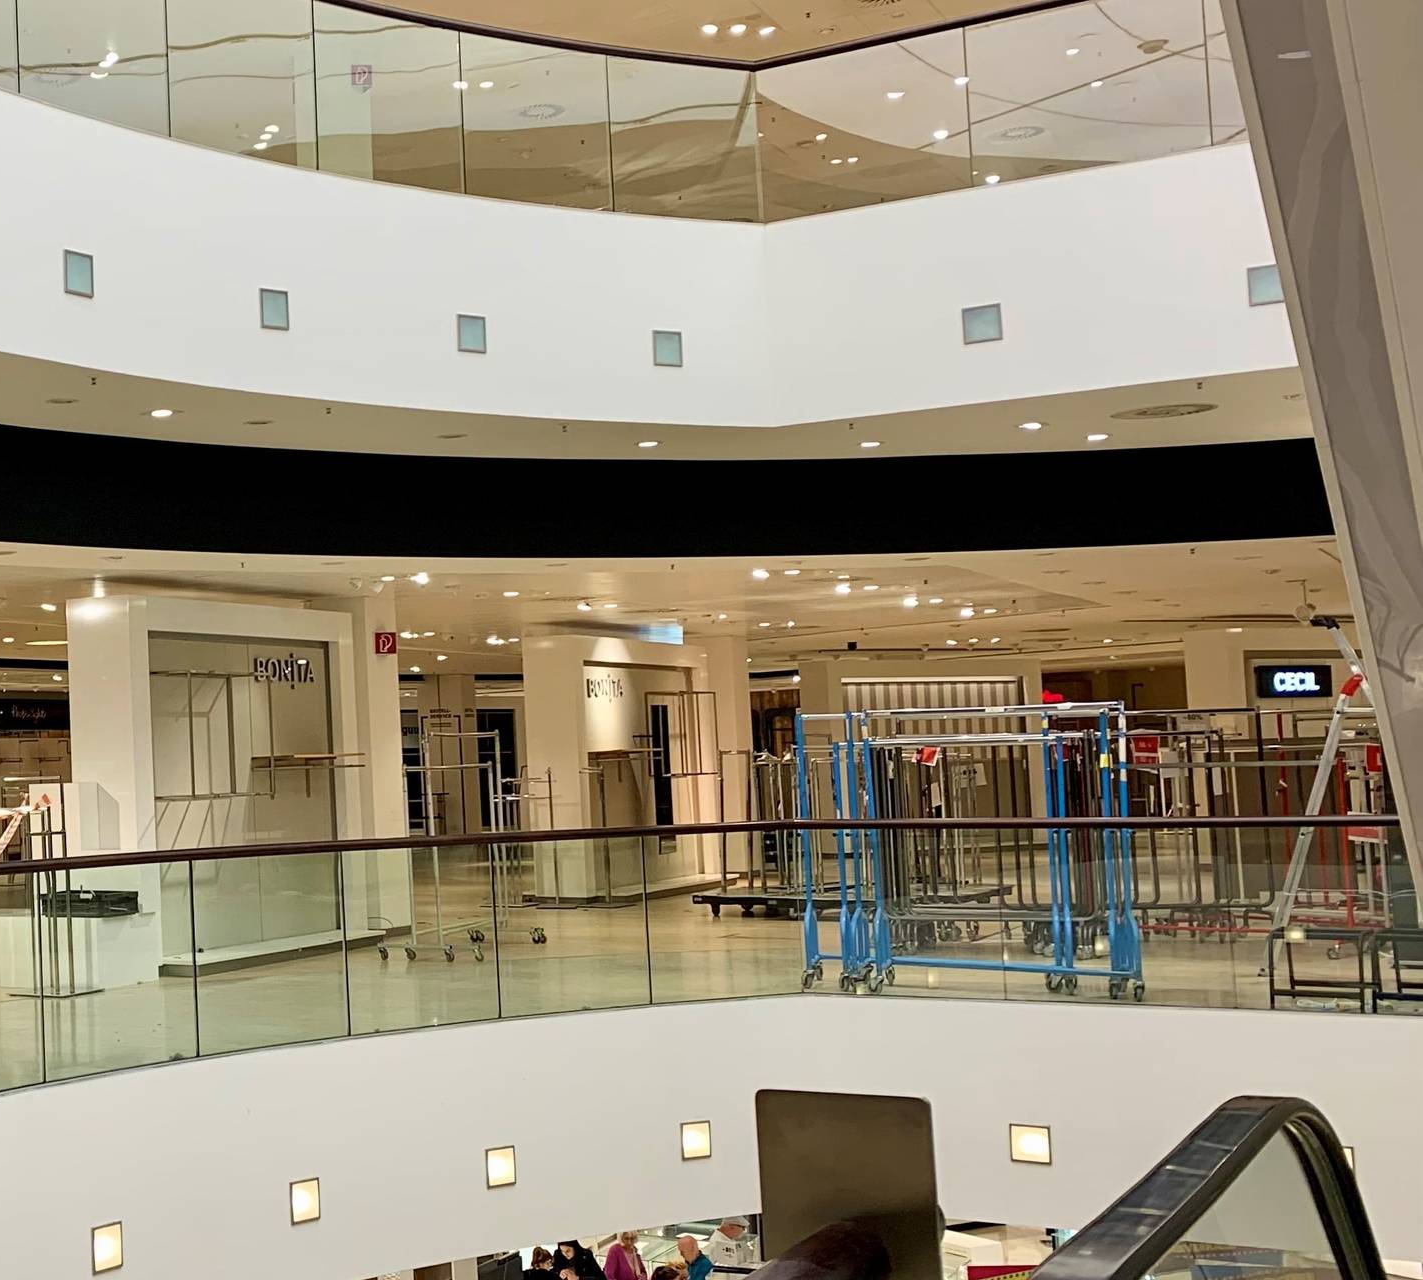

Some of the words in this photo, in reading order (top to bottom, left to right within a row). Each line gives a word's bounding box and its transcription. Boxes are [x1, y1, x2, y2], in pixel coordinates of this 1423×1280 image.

[254, 653, 314, 690] BONITA
[1273, 671, 1321, 692] CECIL
[586, 673, 624, 703] BONITA
